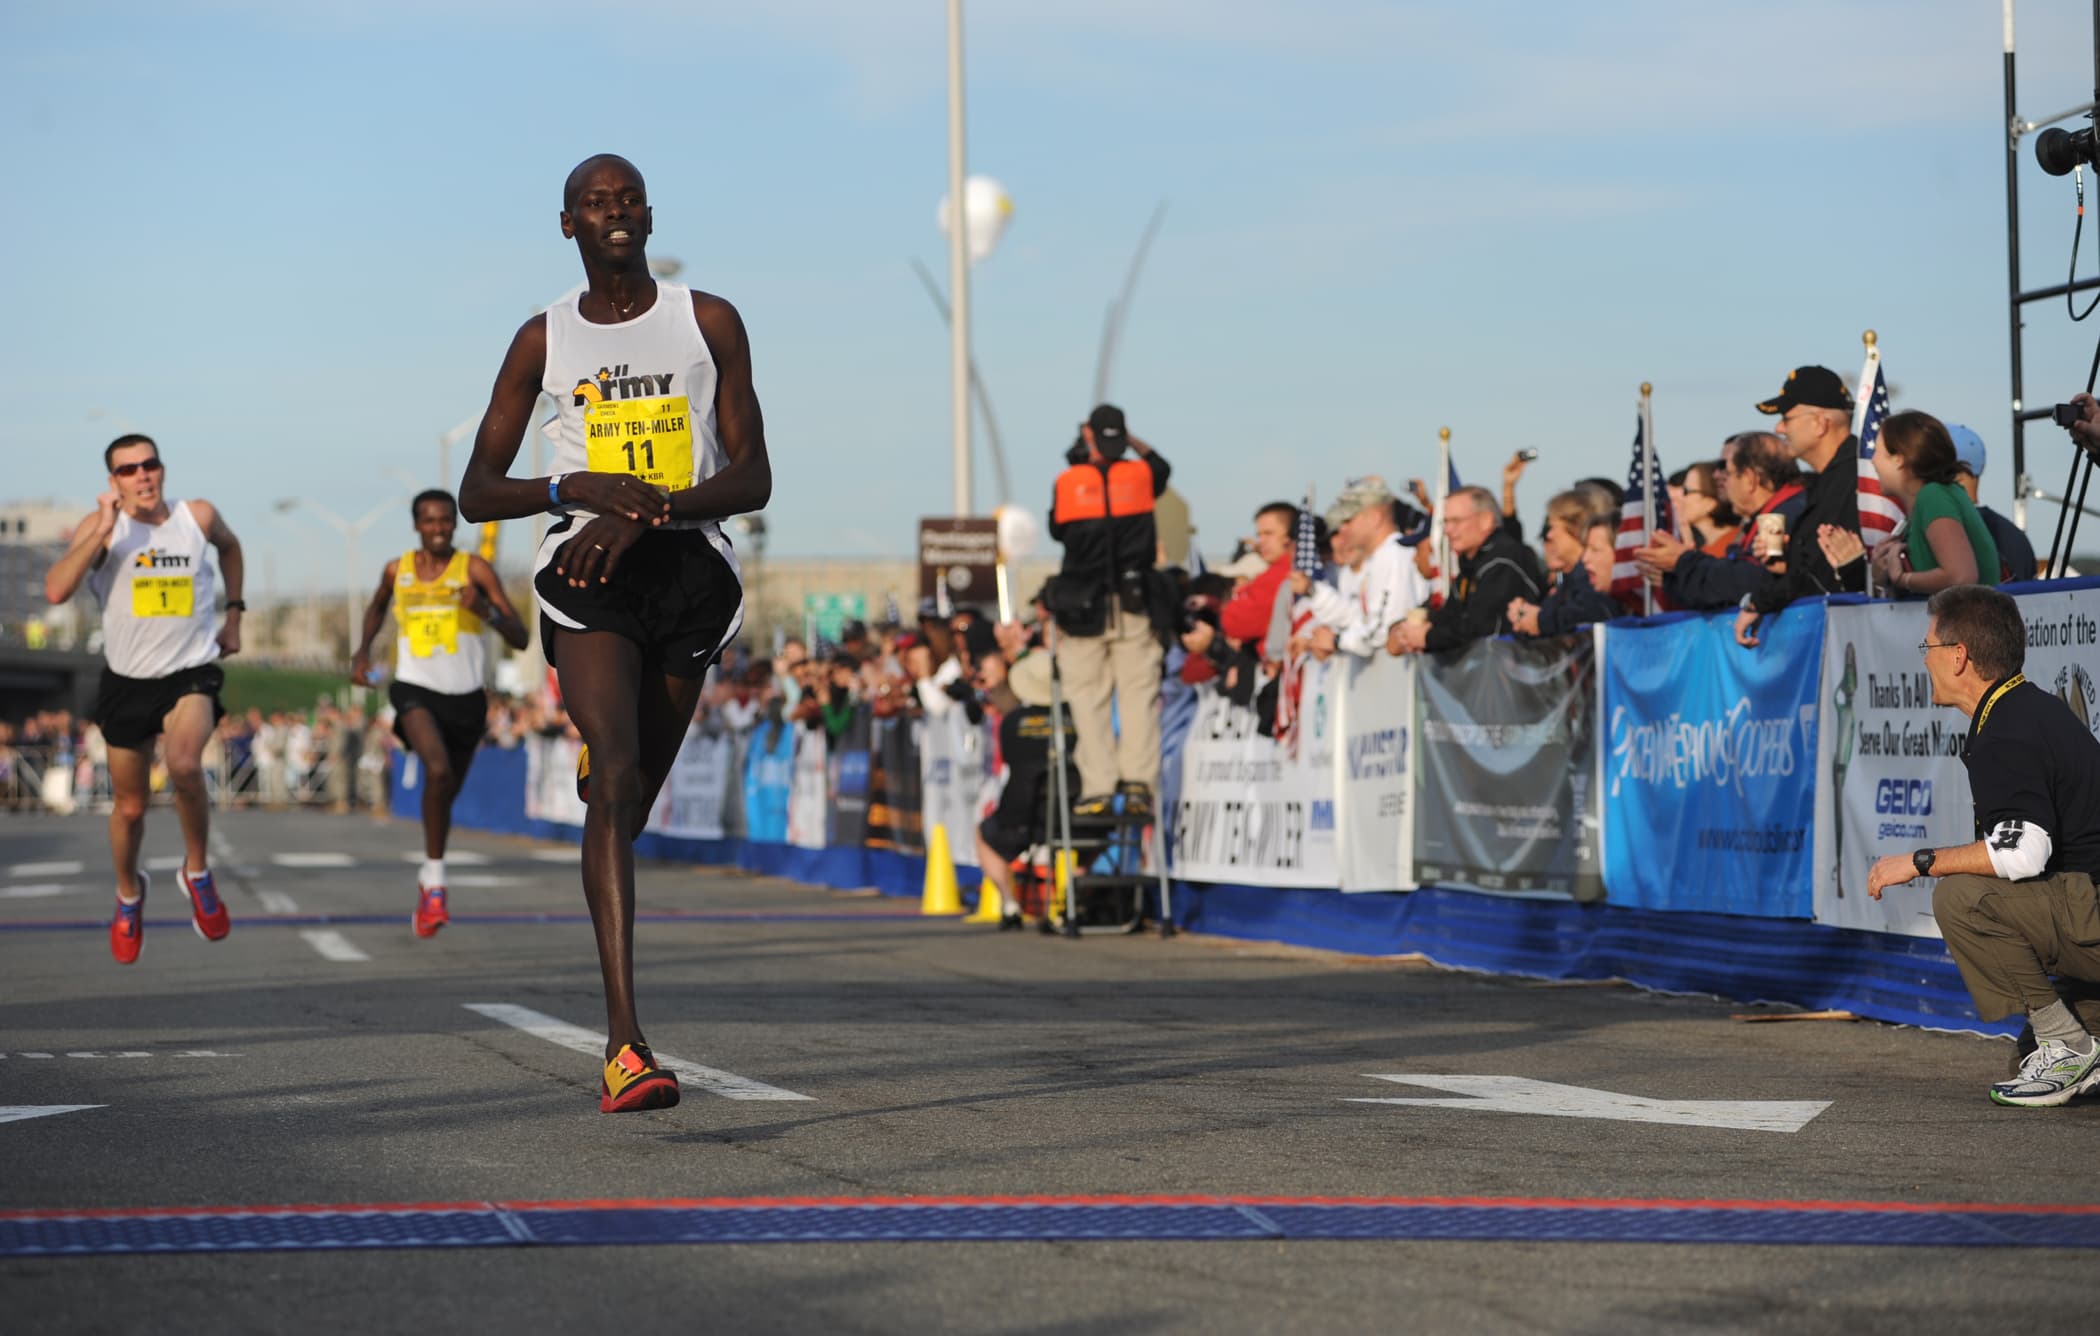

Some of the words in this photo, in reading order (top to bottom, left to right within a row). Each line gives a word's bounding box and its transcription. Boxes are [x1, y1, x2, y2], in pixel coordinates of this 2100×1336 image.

[661, 403, 671, 413] 11
[590, 422, 620, 438] ARMY
[625, 416, 685, 436] TEN-MILER
[622, 439, 655, 471] 11
[648, 472, 665, 481] KBR
[161, 591, 167, 609] 1
[2025, 616, 2058, 648] iation
[2060, 613, 2073, 646] of
[2076, 611, 2097, 646] the
[1868, 672, 1900, 709] Thanks
[1901, 672, 1913, 709] To
[1914, 671, 1929, 709] All
[2054, 664, 2069, 689] THE
[2071, 661, 2097, 705] UNITED
[1859, 719, 1881, 755] Serve
[1883, 719, 1900, 756] Our
[1902, 719, 1930, 757] Great
[1875, 778, 1932, 816] GEICO
[1878, 823, 1927, 840] geico.com
